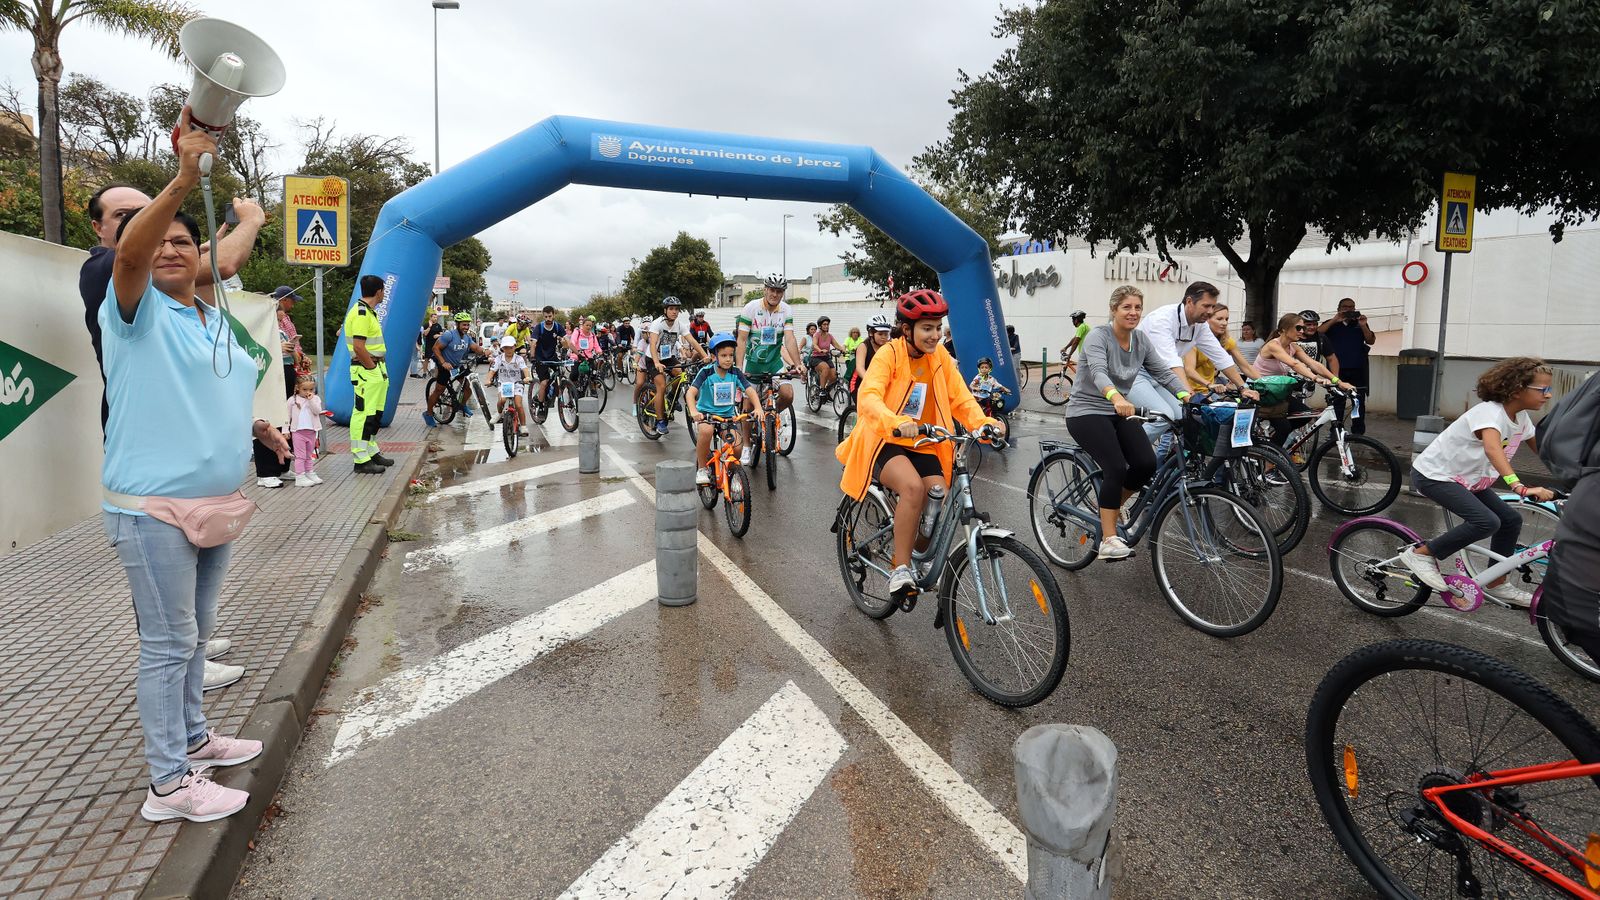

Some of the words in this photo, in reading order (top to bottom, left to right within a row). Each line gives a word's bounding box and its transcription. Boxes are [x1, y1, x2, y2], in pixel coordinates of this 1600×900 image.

[628, 141, 767, 163] Ayuntamiento
[771, 154, 793, 165] de
[796, 156, 842, 168] Jerez
[628, 151, 694, 165] Deportes
[1442, 236, 1468, 248] PEATONES
[294, 249, 341, 262] PEATONES
[1104, 255, 1191, 284] HIPERCOR
